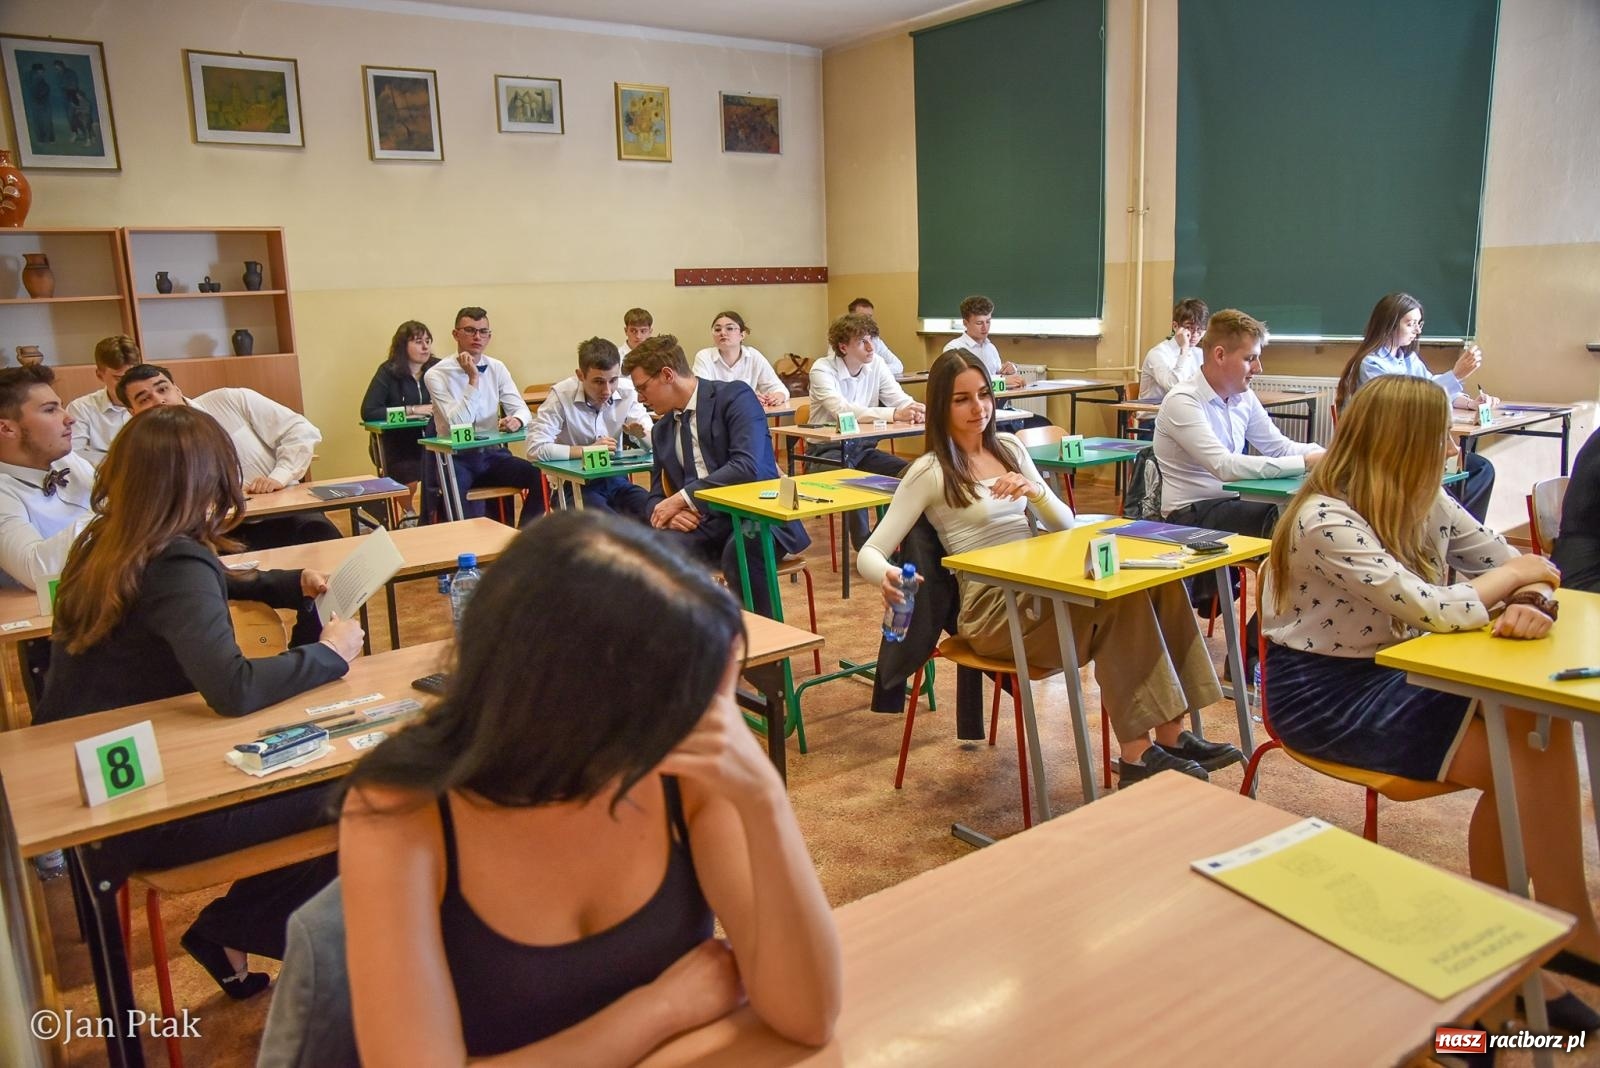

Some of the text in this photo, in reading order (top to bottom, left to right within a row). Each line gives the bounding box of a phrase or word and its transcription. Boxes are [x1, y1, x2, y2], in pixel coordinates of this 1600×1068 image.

[389, 408, 405, 423] 23
[453, 428, 472, 443] 18
[1064, 441, 1082, 459] 11
[587, 453, 608, 469] 15
[1099, 545, 1110, 573] 7
[105, 745, 135, 790] 8
